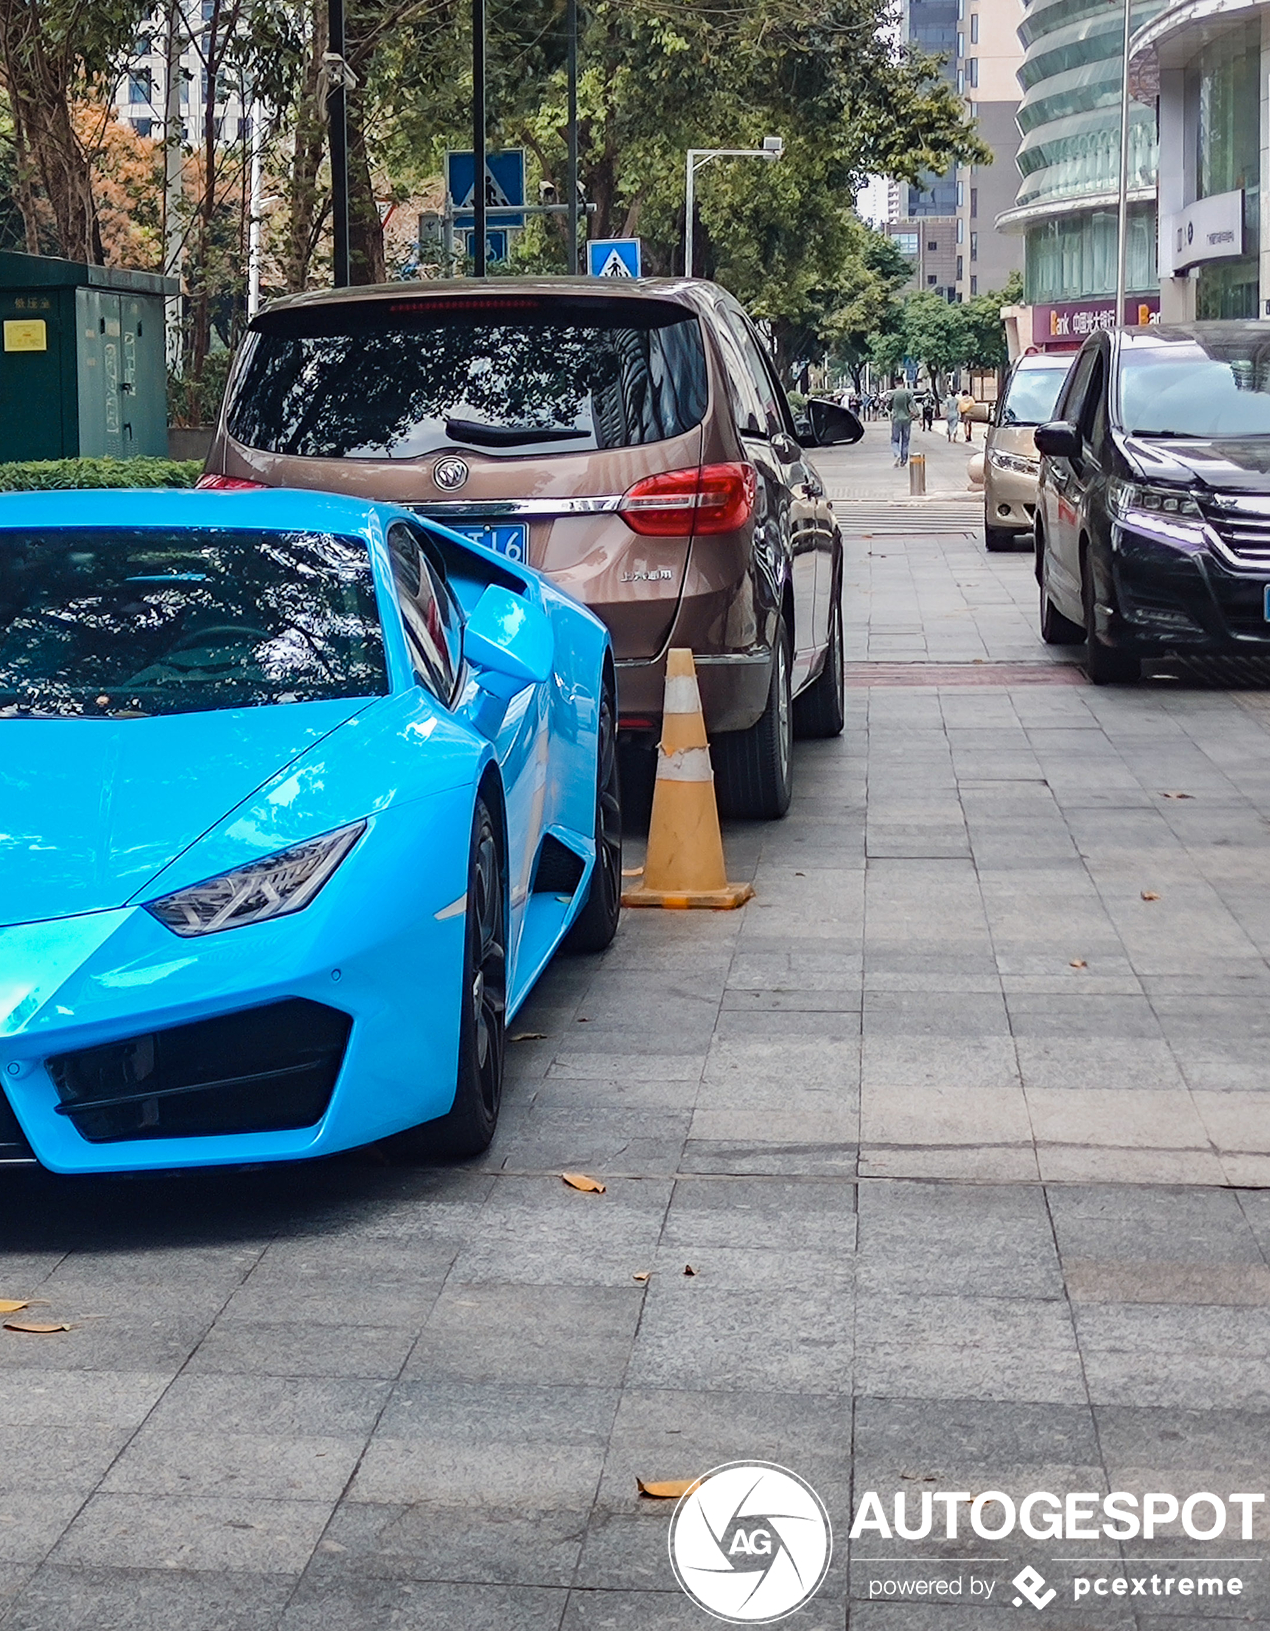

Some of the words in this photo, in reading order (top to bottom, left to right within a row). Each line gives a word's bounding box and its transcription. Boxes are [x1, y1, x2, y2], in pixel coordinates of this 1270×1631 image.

[1050, 310, 1070, 336] Bank
[620, 569, 673, 582] 上汽通用
